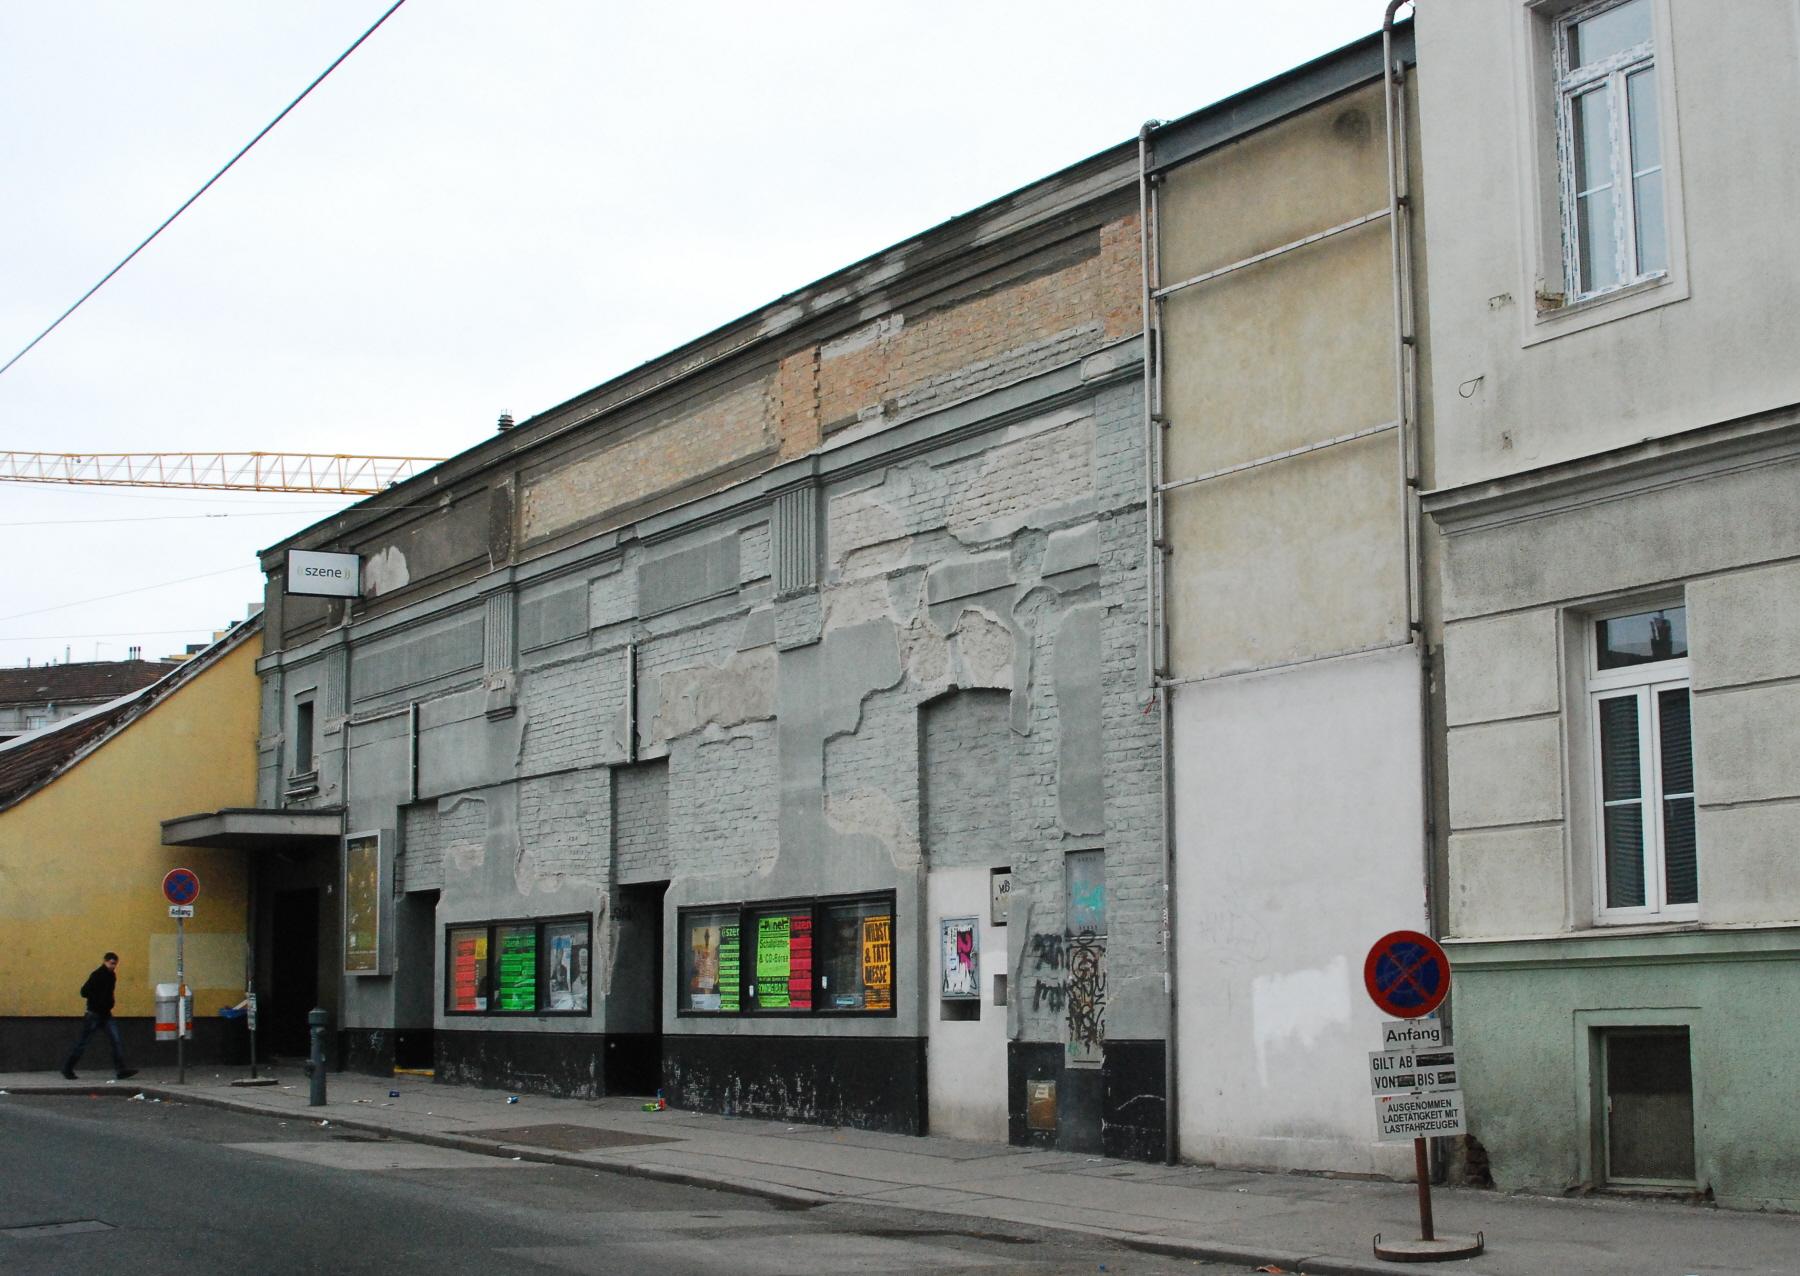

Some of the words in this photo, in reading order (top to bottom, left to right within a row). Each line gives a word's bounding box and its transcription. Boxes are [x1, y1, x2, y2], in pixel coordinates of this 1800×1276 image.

[305, 567, 342, 578] szene
[1386, 1028, 1440, 1042] Anfang
[1373, 1057, 1395, 1070] GILT
[1399, 1056, 1413, 1068] AB
[1375, 1075, 1396, 1088] VON
[1418, 1073, 1435, 1086] BIS
[1388, 1100, 1452, 1112] AUSGENOMMEN
[1383, 1110, 1443, 1123] LADETÄTIGKEIT
[1444, 1108, 1459, 1118] MIT
[1385, 1120, 1459, 1134] LASTFAHRZEUGEN
